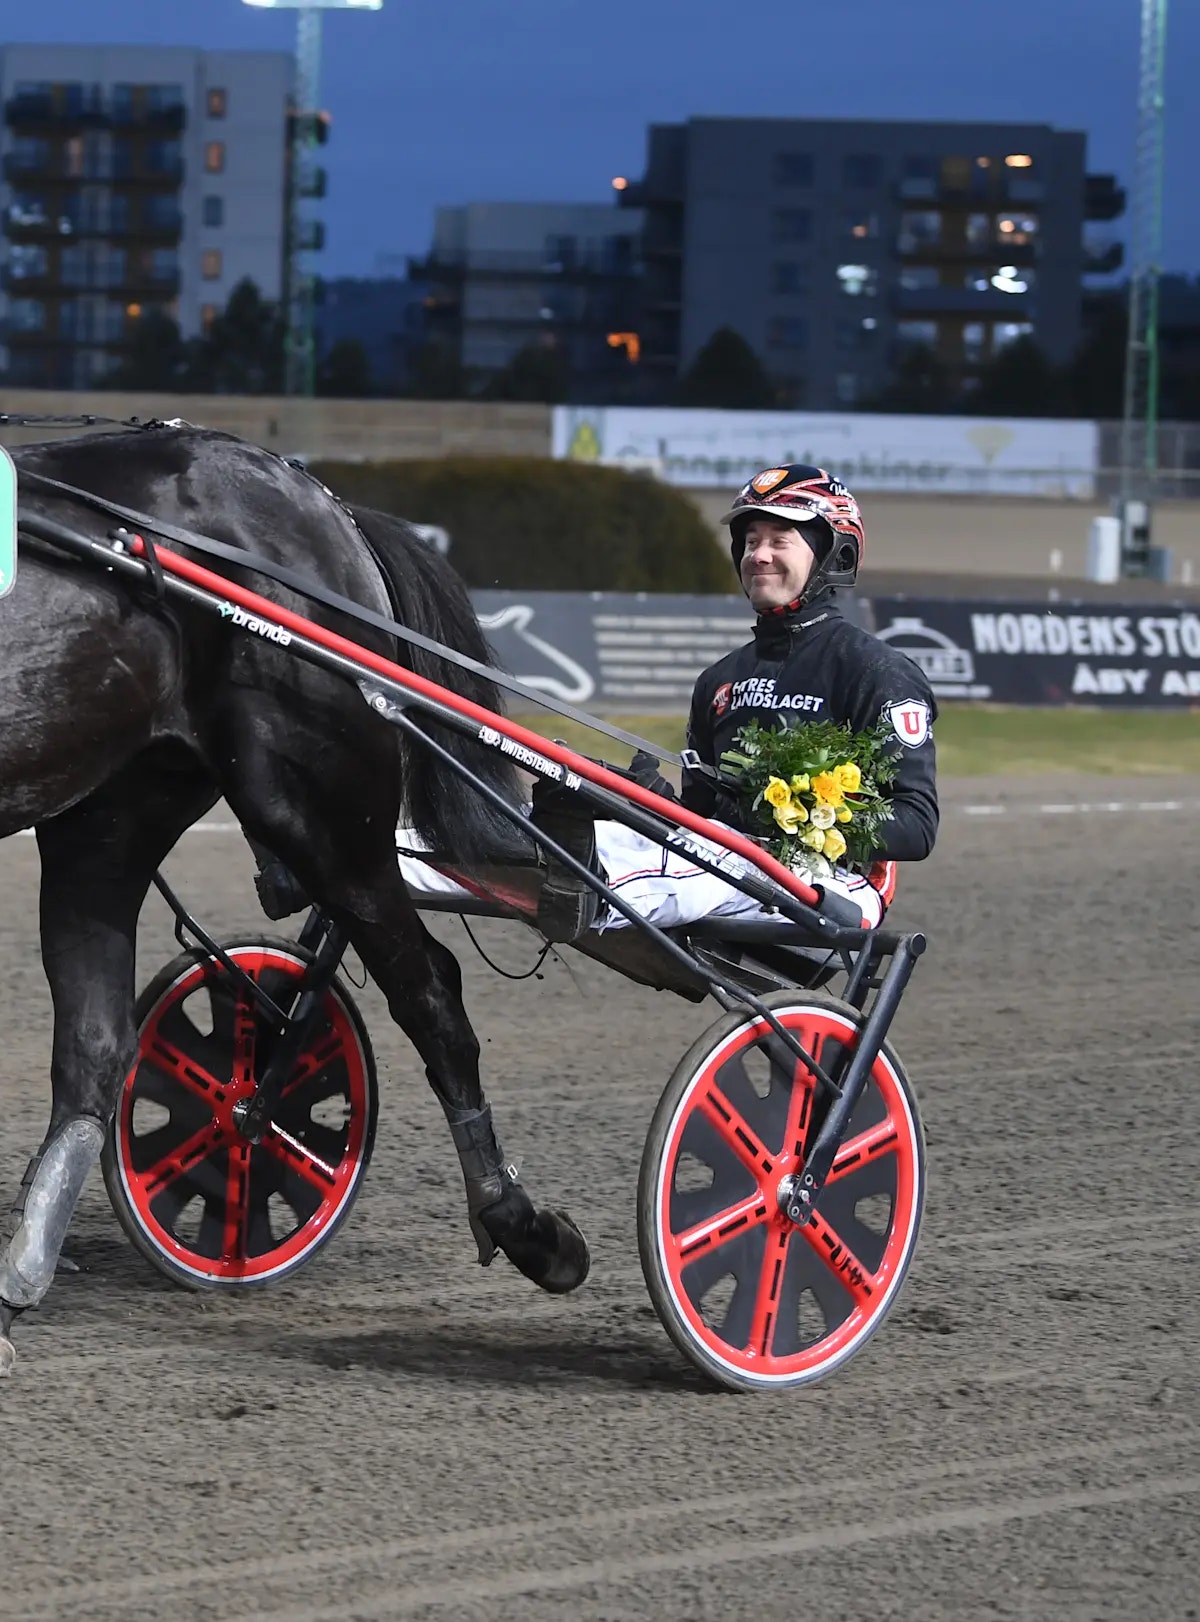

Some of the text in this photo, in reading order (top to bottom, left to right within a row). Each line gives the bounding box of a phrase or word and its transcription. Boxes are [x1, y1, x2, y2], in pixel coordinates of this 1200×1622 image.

[231, 605, 293, 647] bravida
[971, 612, 1137, 656] NORDENS
[730, 692, 824, 713] LANDSLAGET
[901, 711, 920, 735] U
[665, 831, 746, 881] YANKEE
